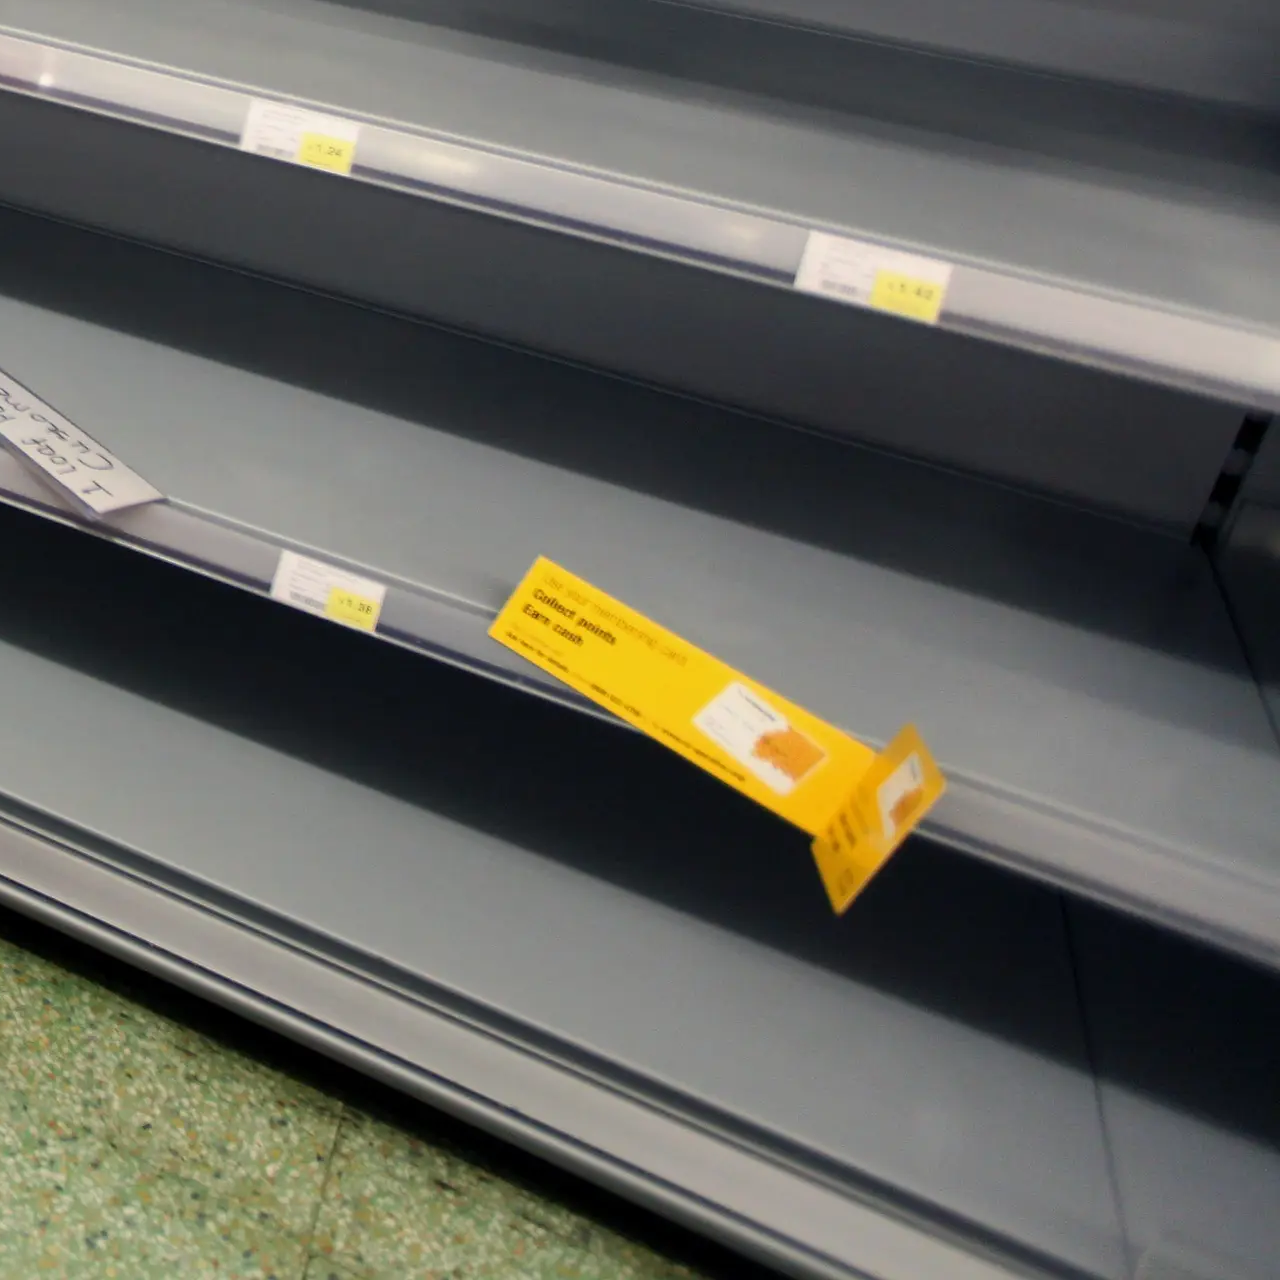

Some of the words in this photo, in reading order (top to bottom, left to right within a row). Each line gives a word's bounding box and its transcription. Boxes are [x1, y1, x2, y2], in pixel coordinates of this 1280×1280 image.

[521, 602, 552, 628] Earn
[552, 621, 585, 649] cash
[531, 588, 577, 621] Collect
[576, 616, 618, 647] points
